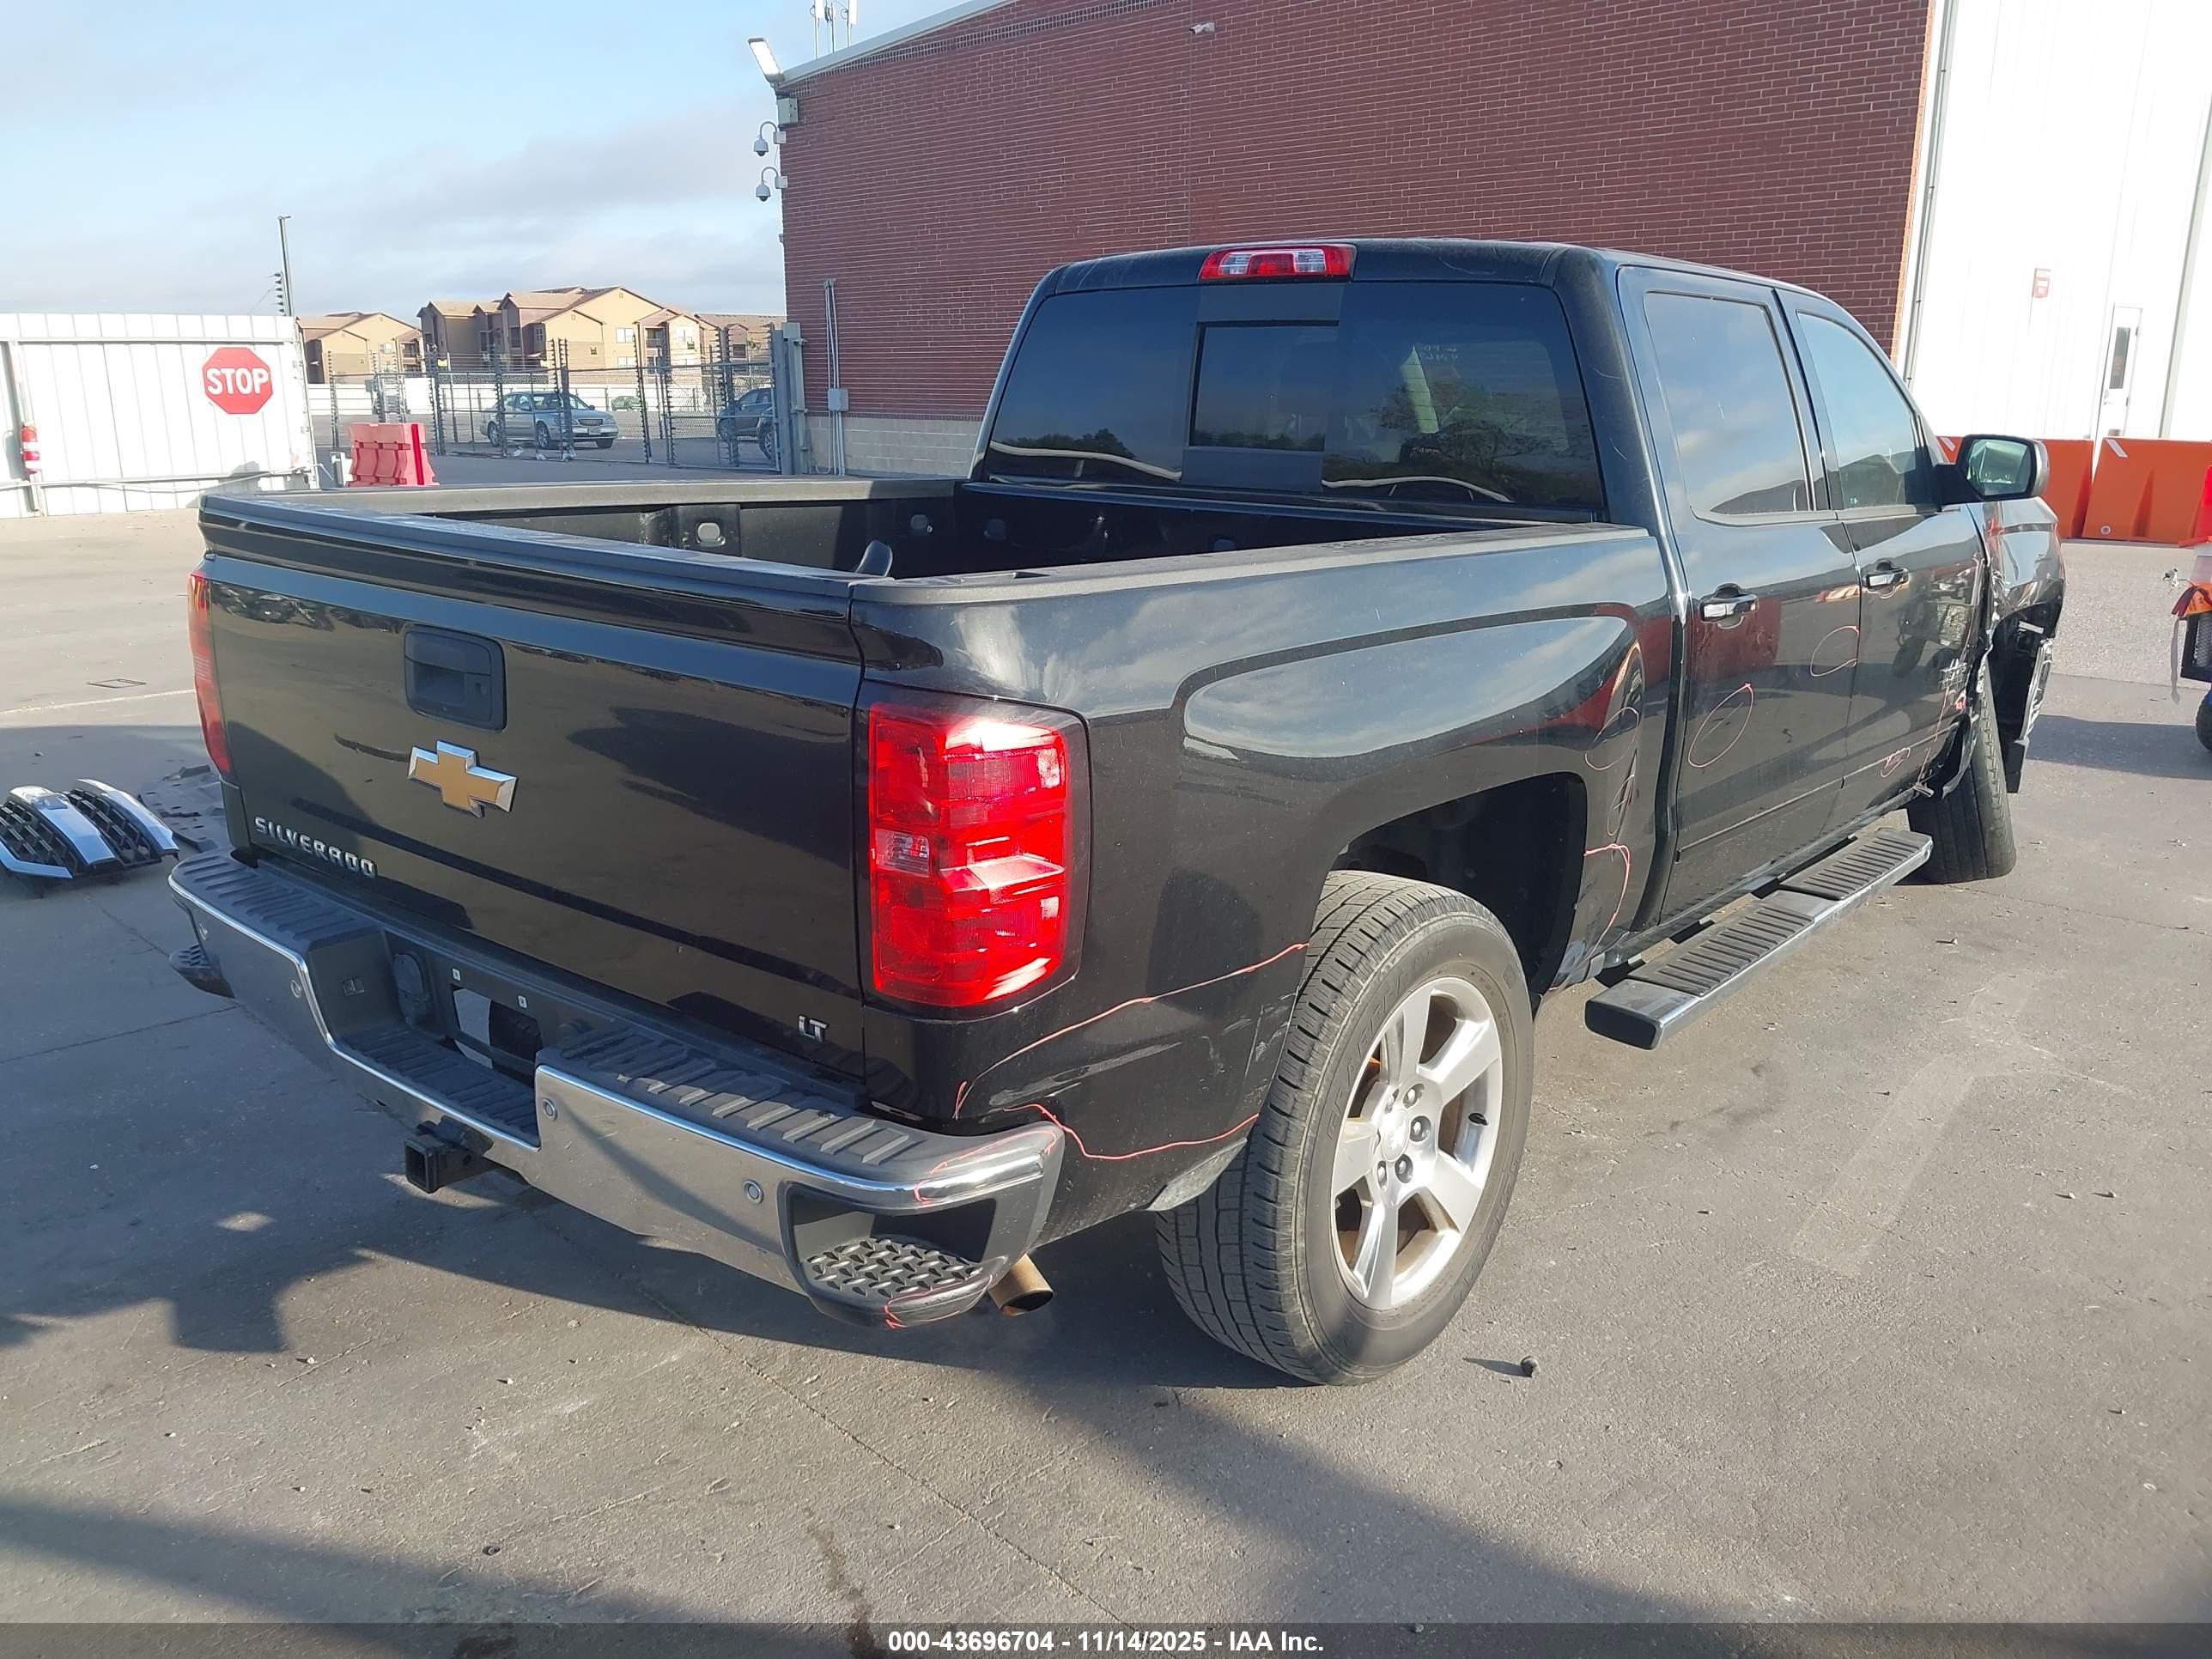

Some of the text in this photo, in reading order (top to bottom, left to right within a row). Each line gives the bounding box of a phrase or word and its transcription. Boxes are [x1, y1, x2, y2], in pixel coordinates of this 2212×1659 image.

[206, 368, 269, 395] STOP
[255, 817, 376, 878] SILVERADO
[799, 1015, 828, 1042] LT
